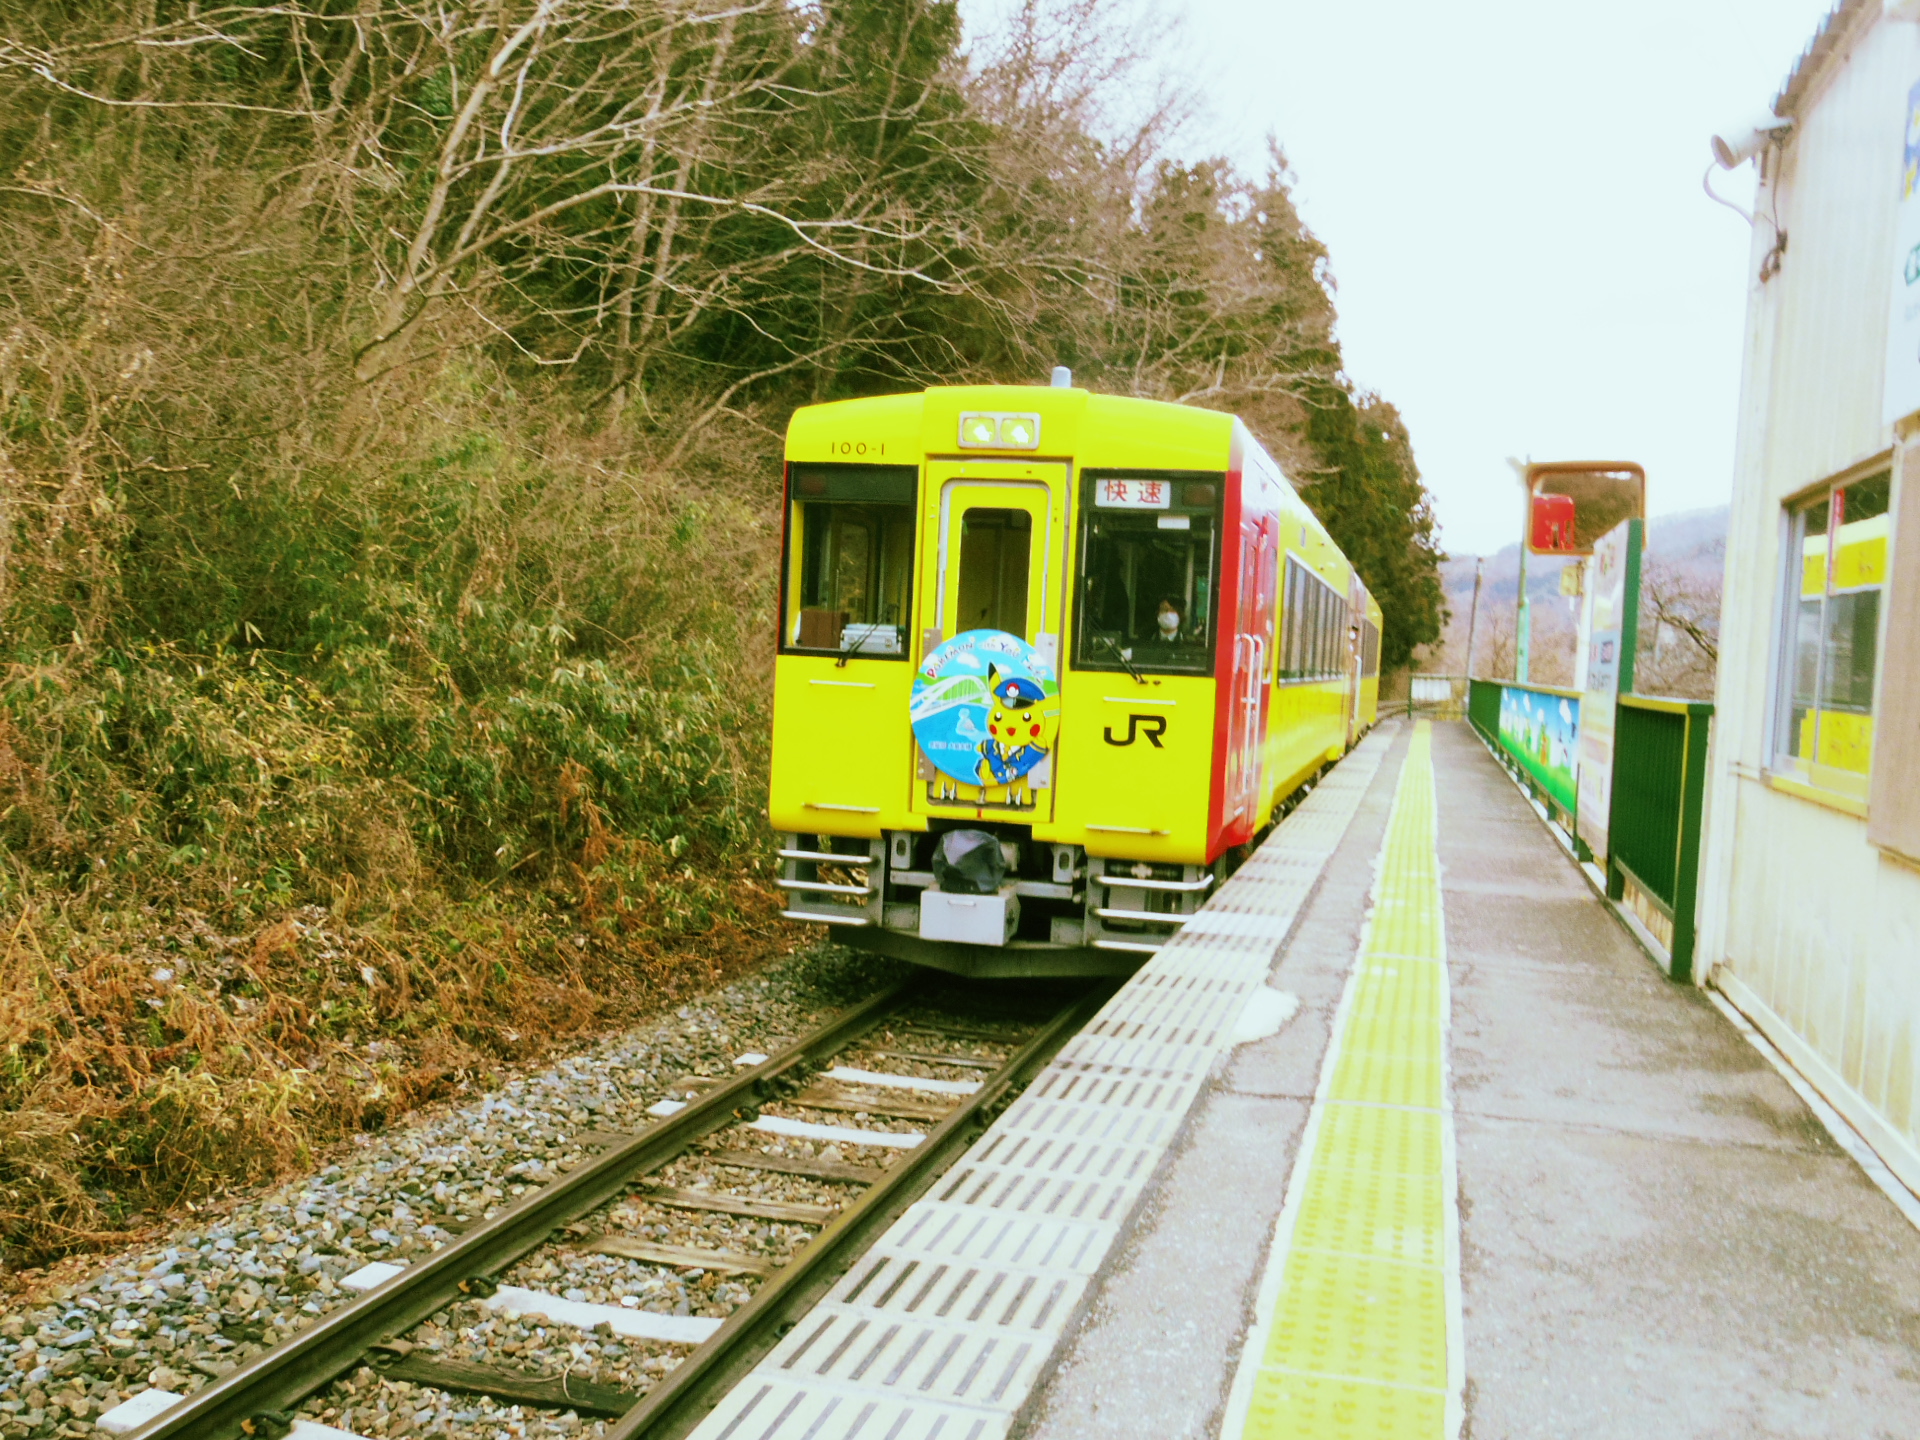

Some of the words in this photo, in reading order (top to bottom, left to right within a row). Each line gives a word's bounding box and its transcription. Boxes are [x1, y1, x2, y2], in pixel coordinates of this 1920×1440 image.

[831, 442, 885, 456] 100-1
[1104, 480, 1162, 504] 快速
[1103, 714, 1167, 748] JR
